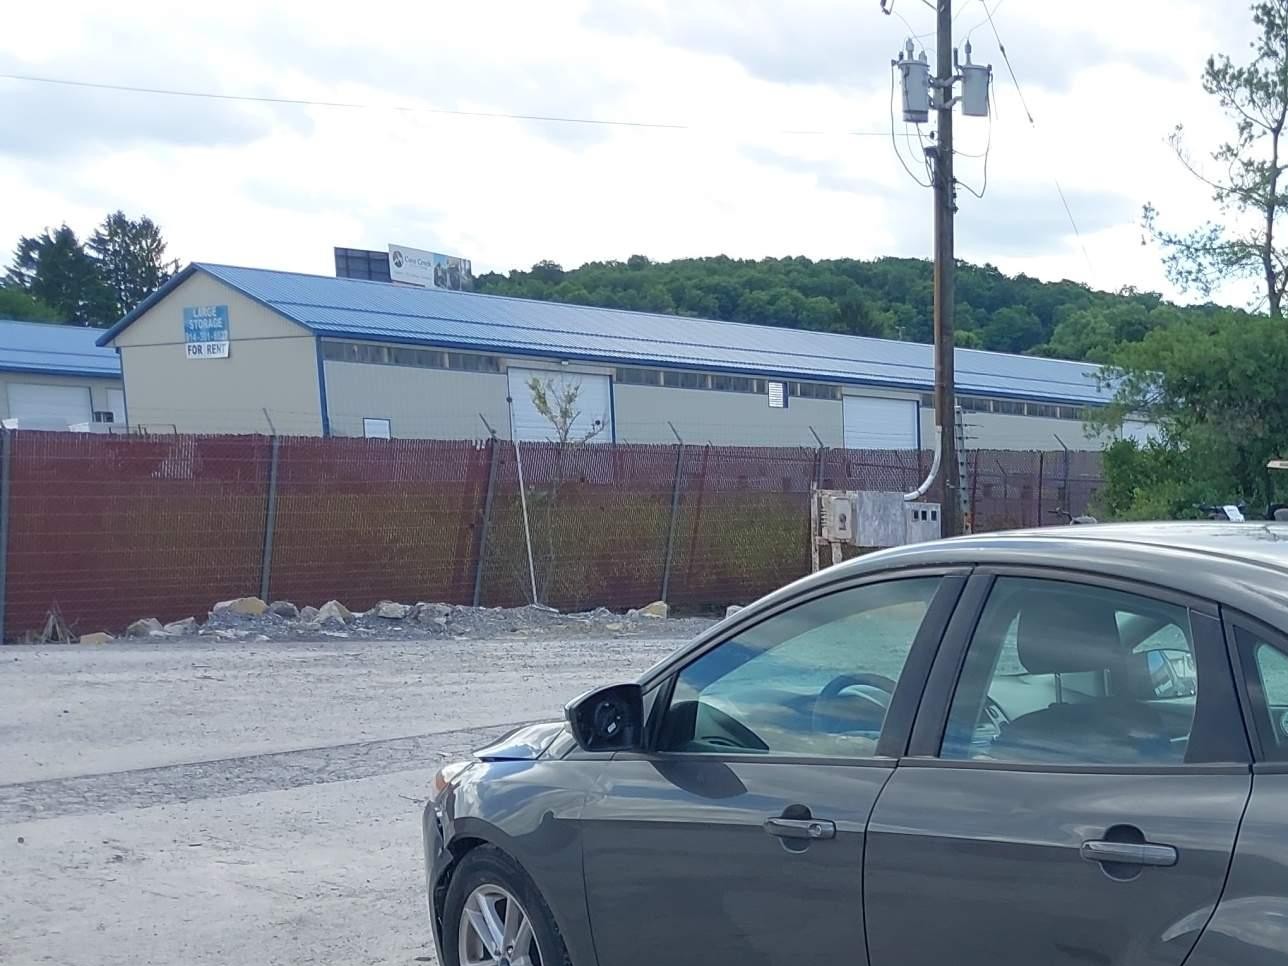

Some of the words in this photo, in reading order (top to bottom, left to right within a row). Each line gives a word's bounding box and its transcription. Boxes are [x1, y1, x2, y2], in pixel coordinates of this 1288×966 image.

[193, 306, 217, 318] LARGE
[188, 317, 223, 330] STORAGE
[187, 344, 203, 355] FOR
[207, 343, 226, 354] RENT
